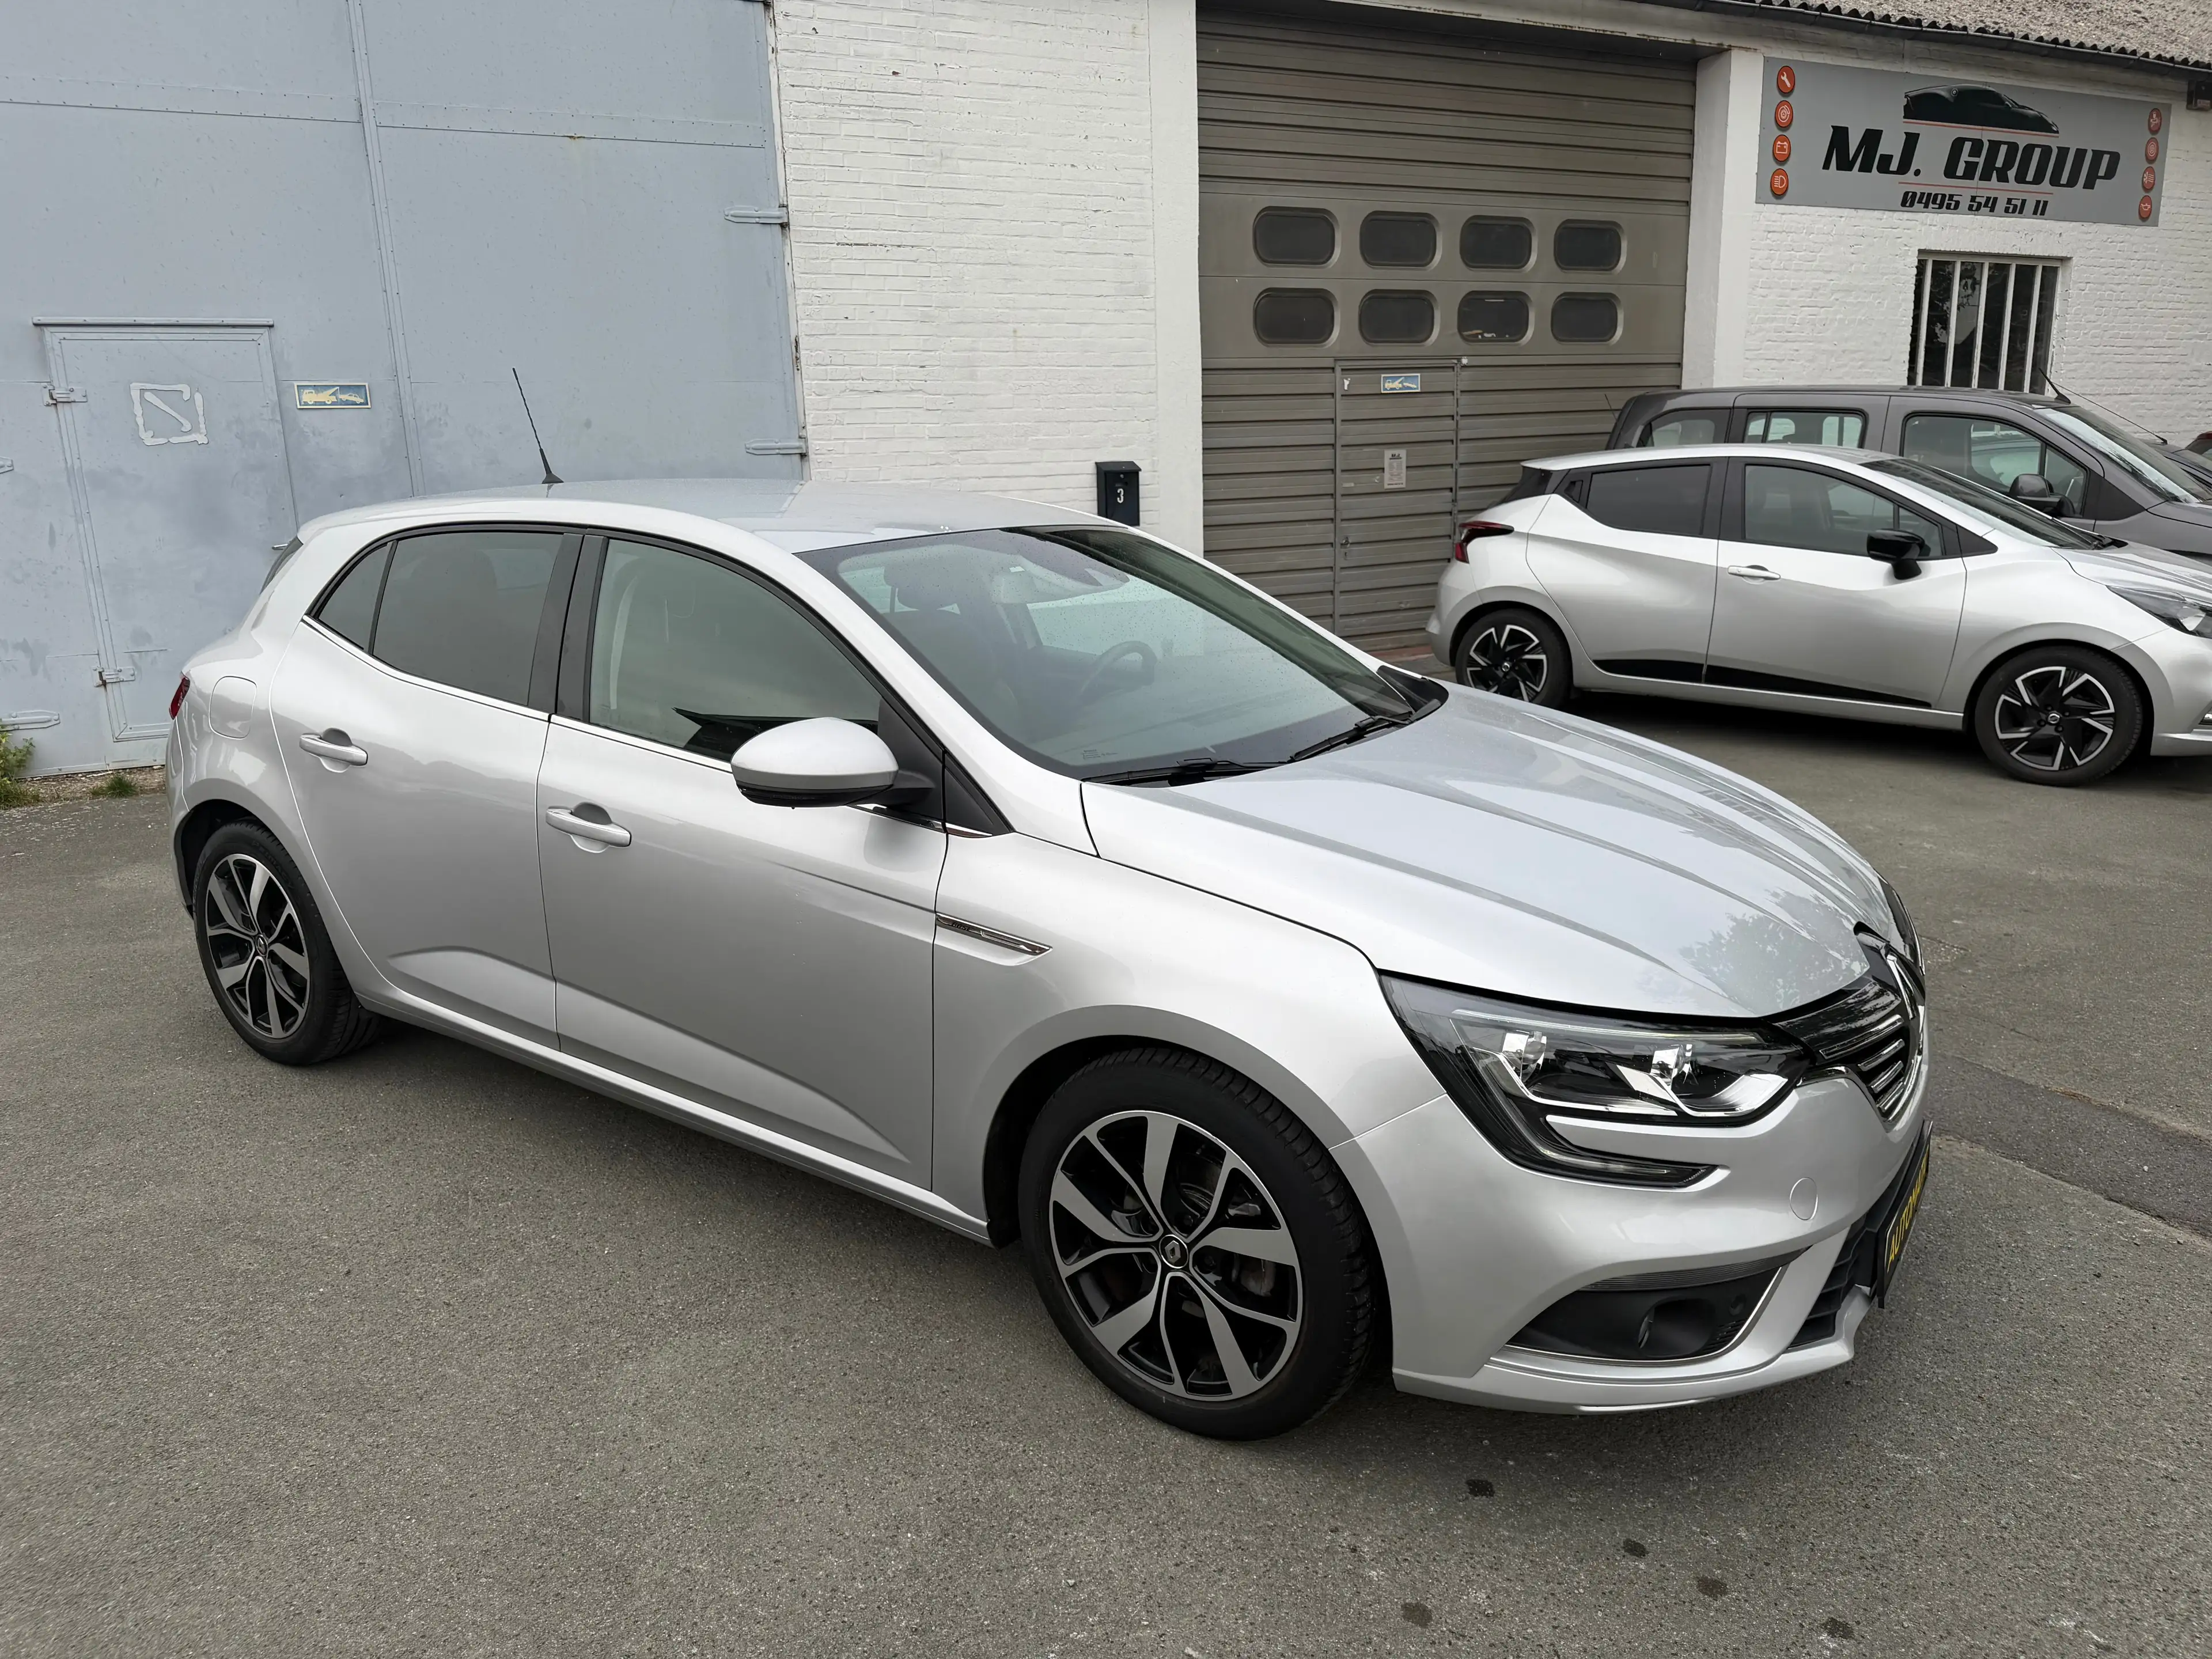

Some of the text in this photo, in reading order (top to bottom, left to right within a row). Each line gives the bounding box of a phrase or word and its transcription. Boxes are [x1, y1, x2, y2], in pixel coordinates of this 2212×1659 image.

[1822, 125, 2120, 190] MJ. GROUP
[1901, 191, 2048, 216] 0495 54 51 11
[1117, 488, 1124, 503] 3
